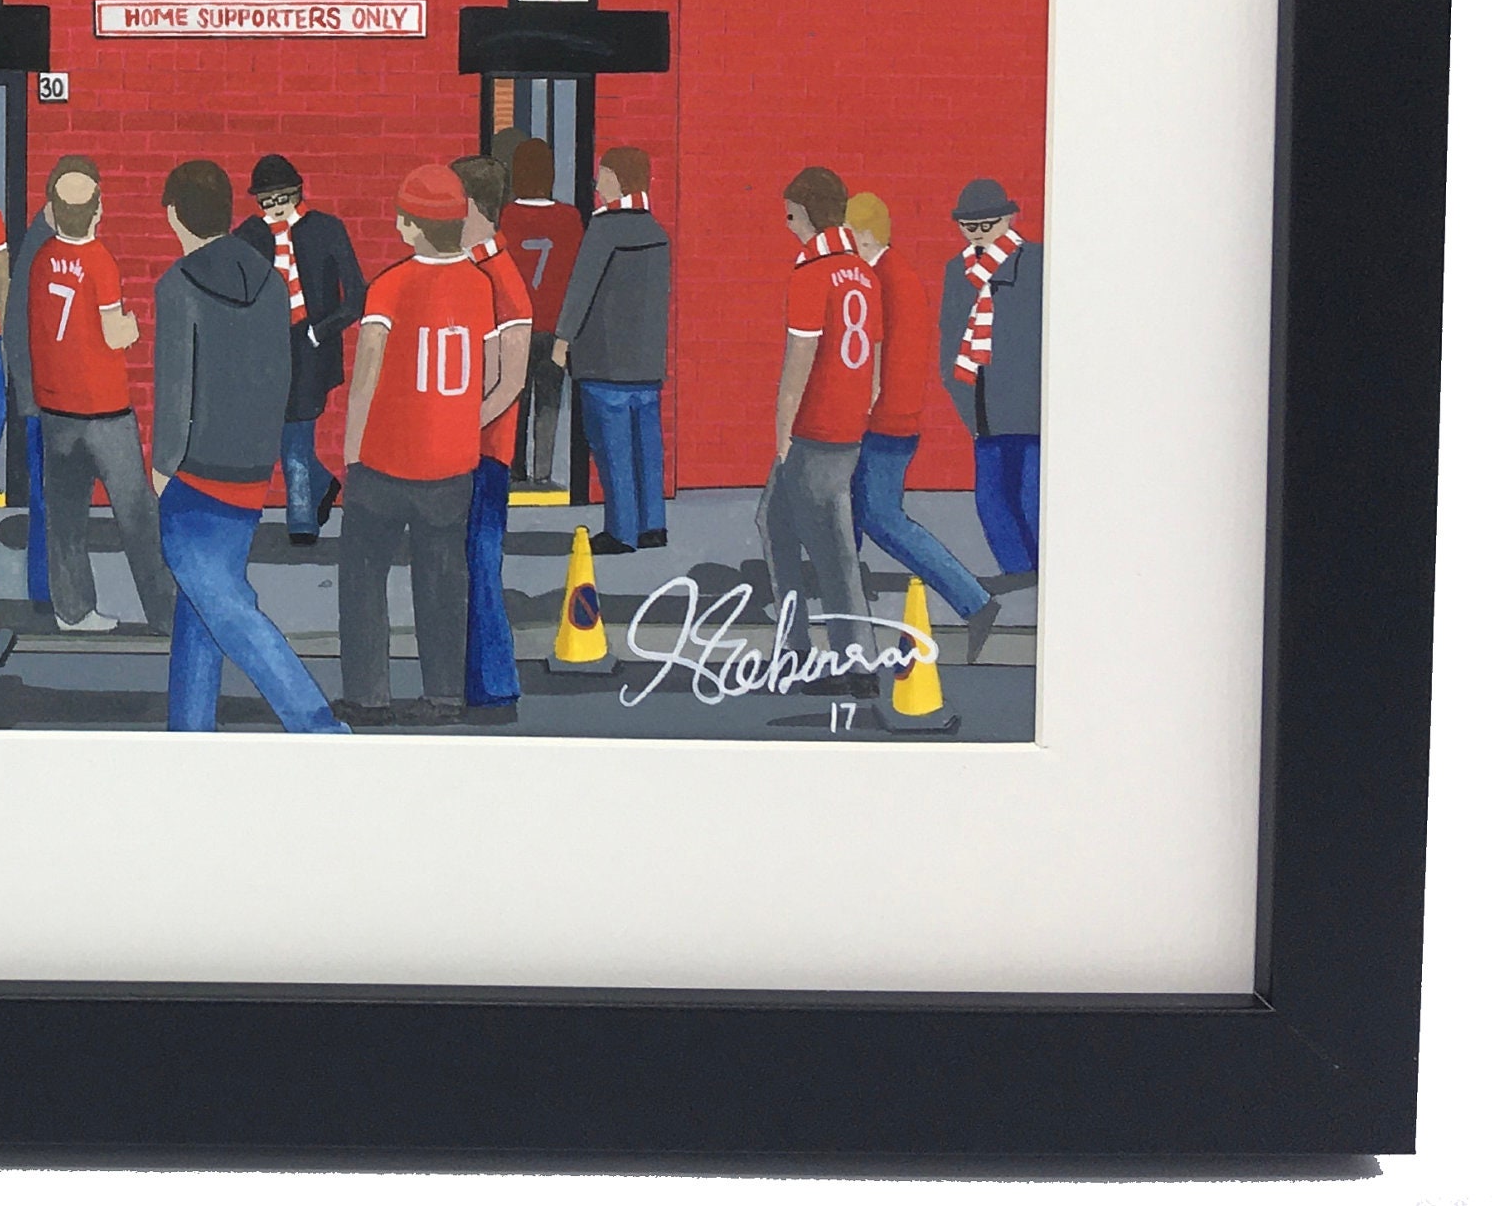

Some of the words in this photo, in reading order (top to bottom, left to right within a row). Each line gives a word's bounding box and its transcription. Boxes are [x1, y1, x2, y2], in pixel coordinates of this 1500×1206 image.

[124, 7, 188, 28] HOME
[197, 6, 341, 30] SUPPORTERS
[352, 6, 408, 29] ONLY
[40, 77, 64, 98] 30
[521, 238, 553, 290] 7
[48, 282, 76, 342] 7
[840, 289, 870, 370] 8
[416, 325, 471, 396] 10
[829, 701, 857, 733] 17
